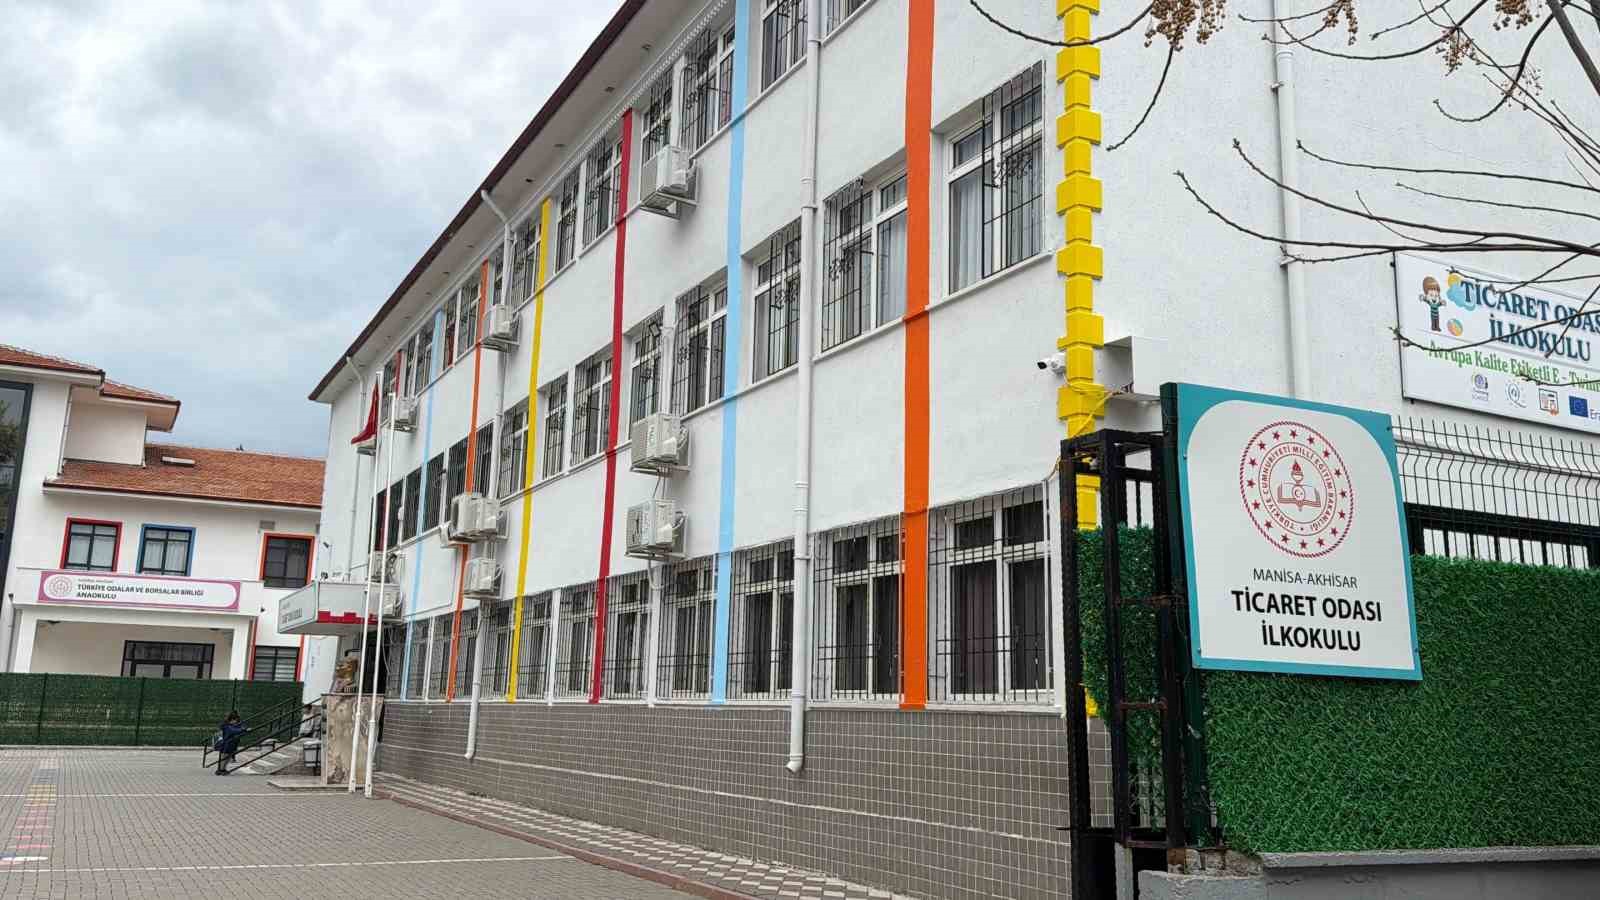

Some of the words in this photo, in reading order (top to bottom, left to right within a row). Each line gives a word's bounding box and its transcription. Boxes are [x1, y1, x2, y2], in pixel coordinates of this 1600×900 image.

[1461, 280, 1550, 321] TİCARET
[1489, 313, 1590, 361] İLKOKULU
[1428, 340, 1472, 368] Avrupa
[1475, 350, 1508, 373] Kalite
[1511, 358, 1551, 383] Etiketli
[1552, 367, 1560, 384] E
[78, 583, 105, 591] TÜRKİYE
[106, 585, 134, 593] ODALAR
[145, 587, 179, 595] BORSALAR
[1253, 568, 1358, 588] MANİSA-AKHİSAR
[77, 591, 117, 600] ANAOKULU
[1231, 586, 1317, 617] TİCARET
[1322, 598, 1382, 621] ODASI
[1262, 620, 1361, 651] İLKOKULU
